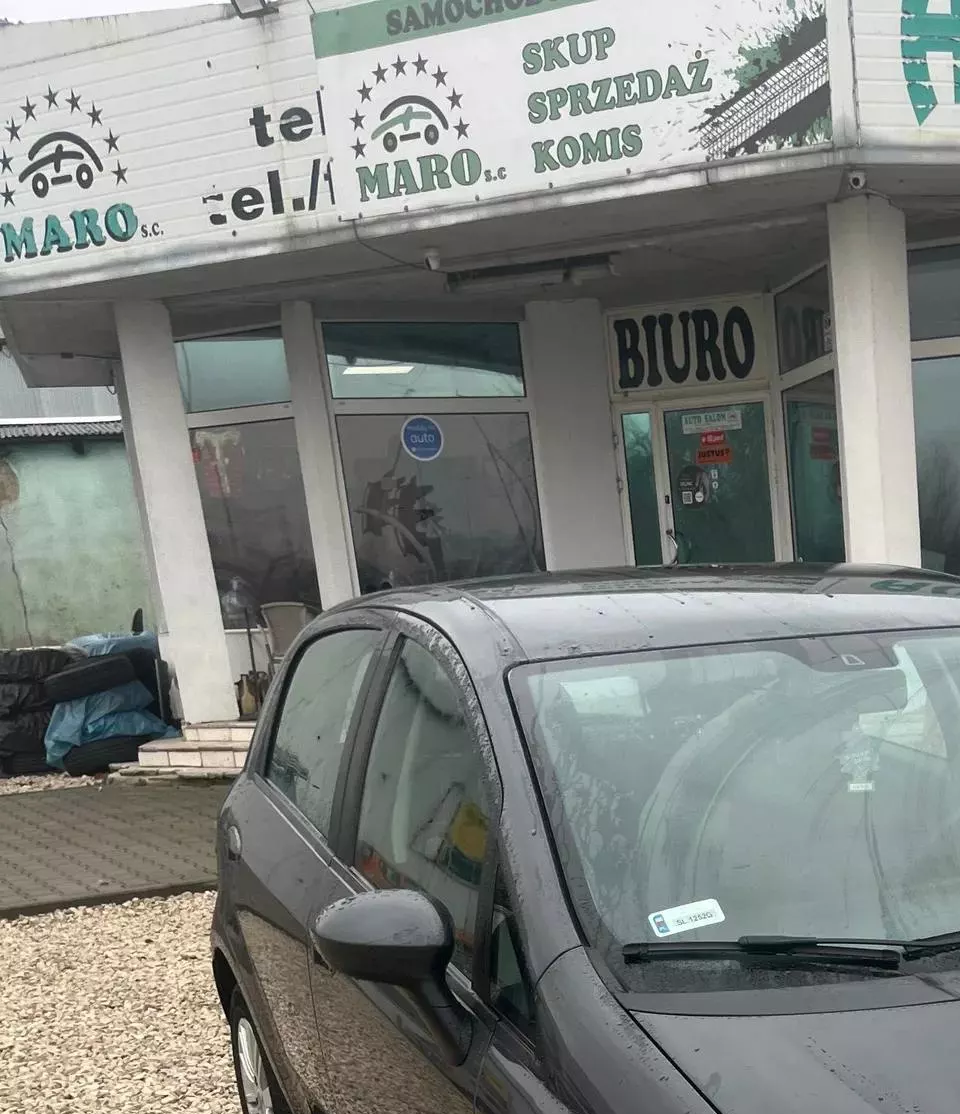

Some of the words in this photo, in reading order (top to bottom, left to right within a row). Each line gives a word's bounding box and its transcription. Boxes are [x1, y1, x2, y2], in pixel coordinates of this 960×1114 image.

[386, 0, 543, 36] SAMOCH
[522, 27, 616, 75] SKUP
[528, 49, 712, 124] SPRZEDAŻ
[531, 124, 643, 173] KOMIS
[356, 148, 482, 202] MARO
[0, 203, 138, 262] MARO
[141, 222, 164, 238] s.c.
[614, 306, 755, 388] BIURO
[410, 433, 435, 443] auto
